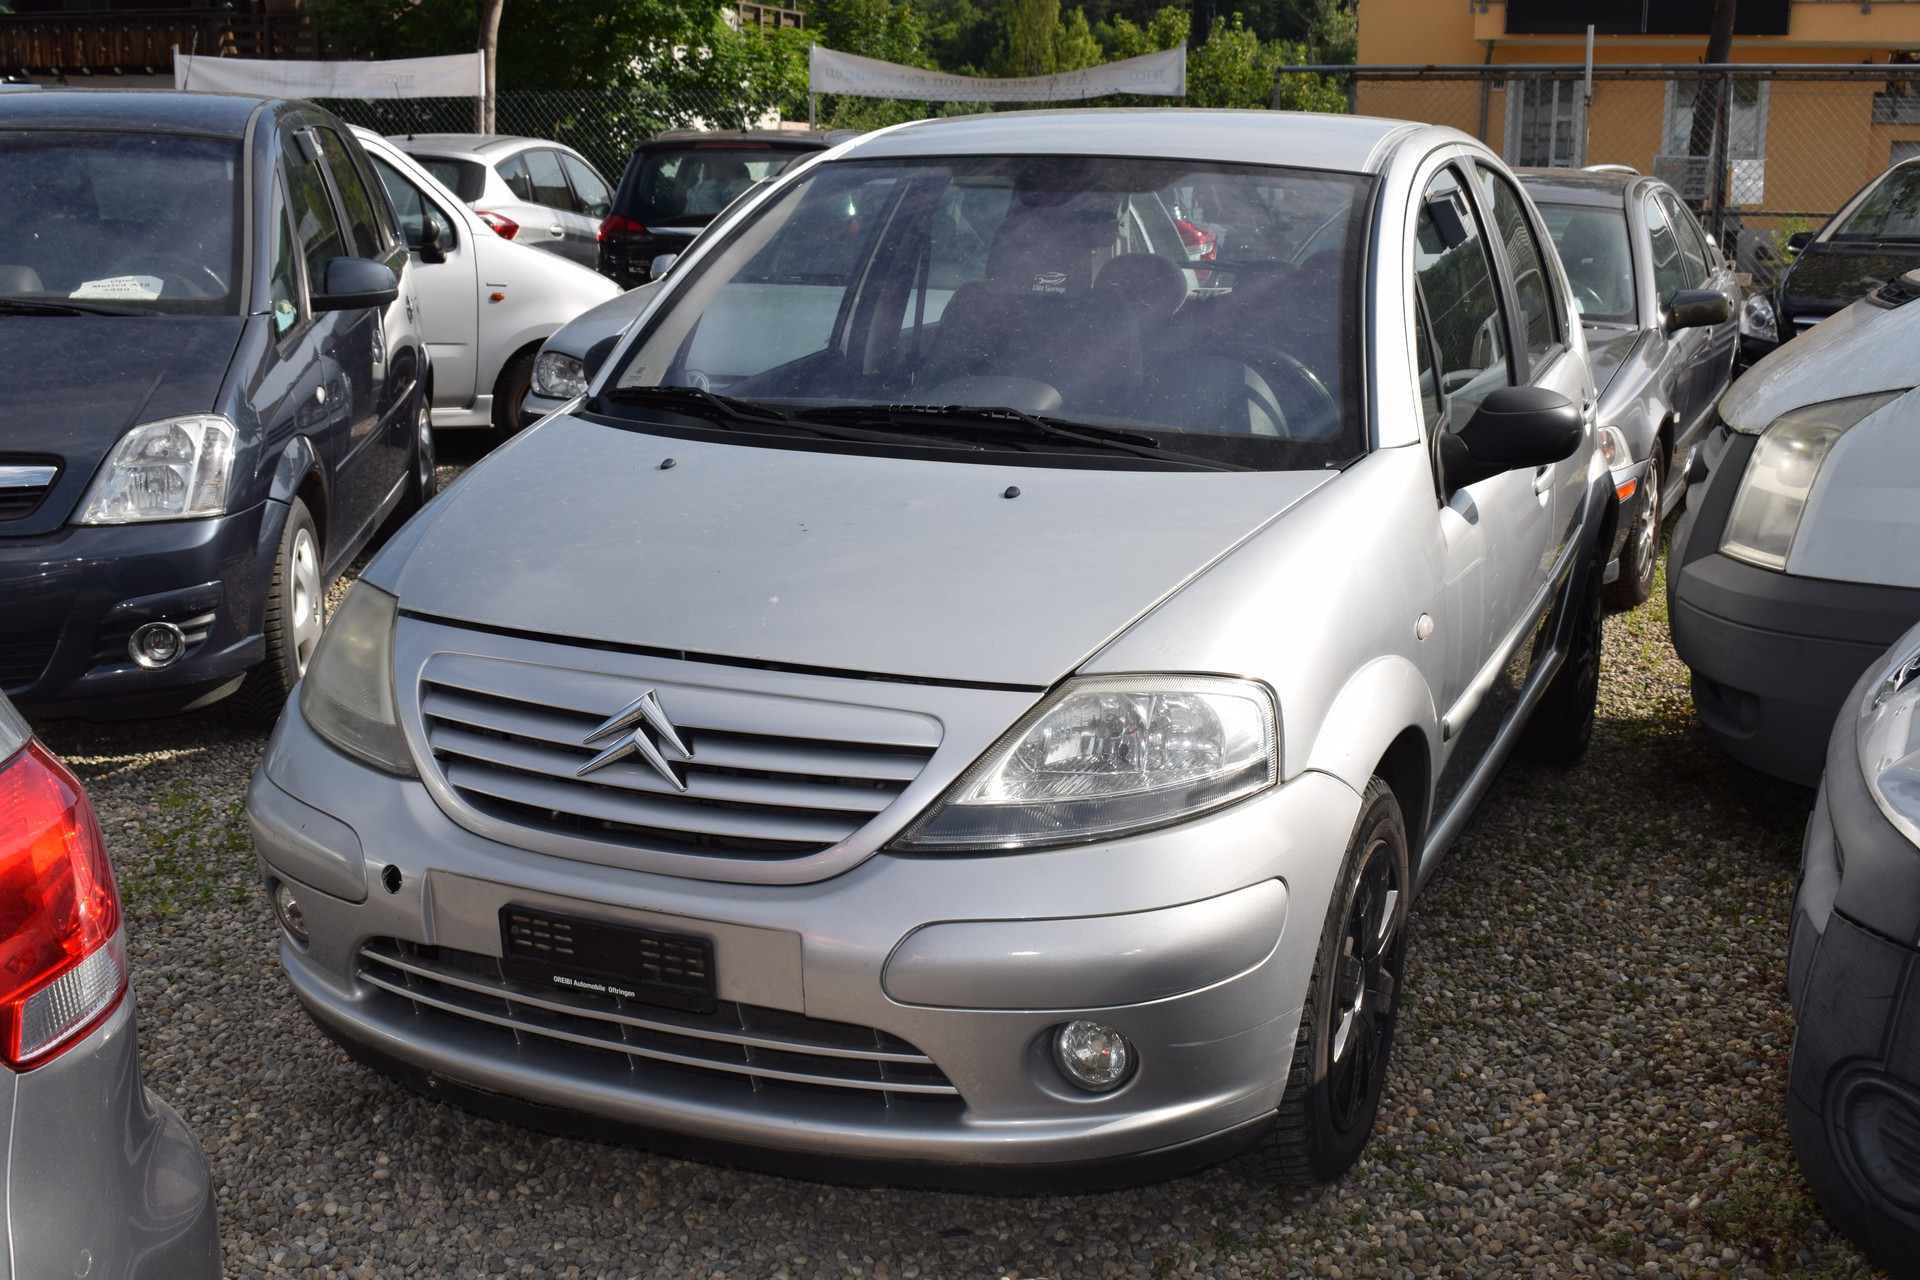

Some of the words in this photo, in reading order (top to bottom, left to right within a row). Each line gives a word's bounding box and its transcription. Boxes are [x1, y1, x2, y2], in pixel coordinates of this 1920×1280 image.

[1045, 285, 1067, 294] Garage
[573, 979, 606, 992] Automobile
[608, 986, 636, 997] Oftringen
